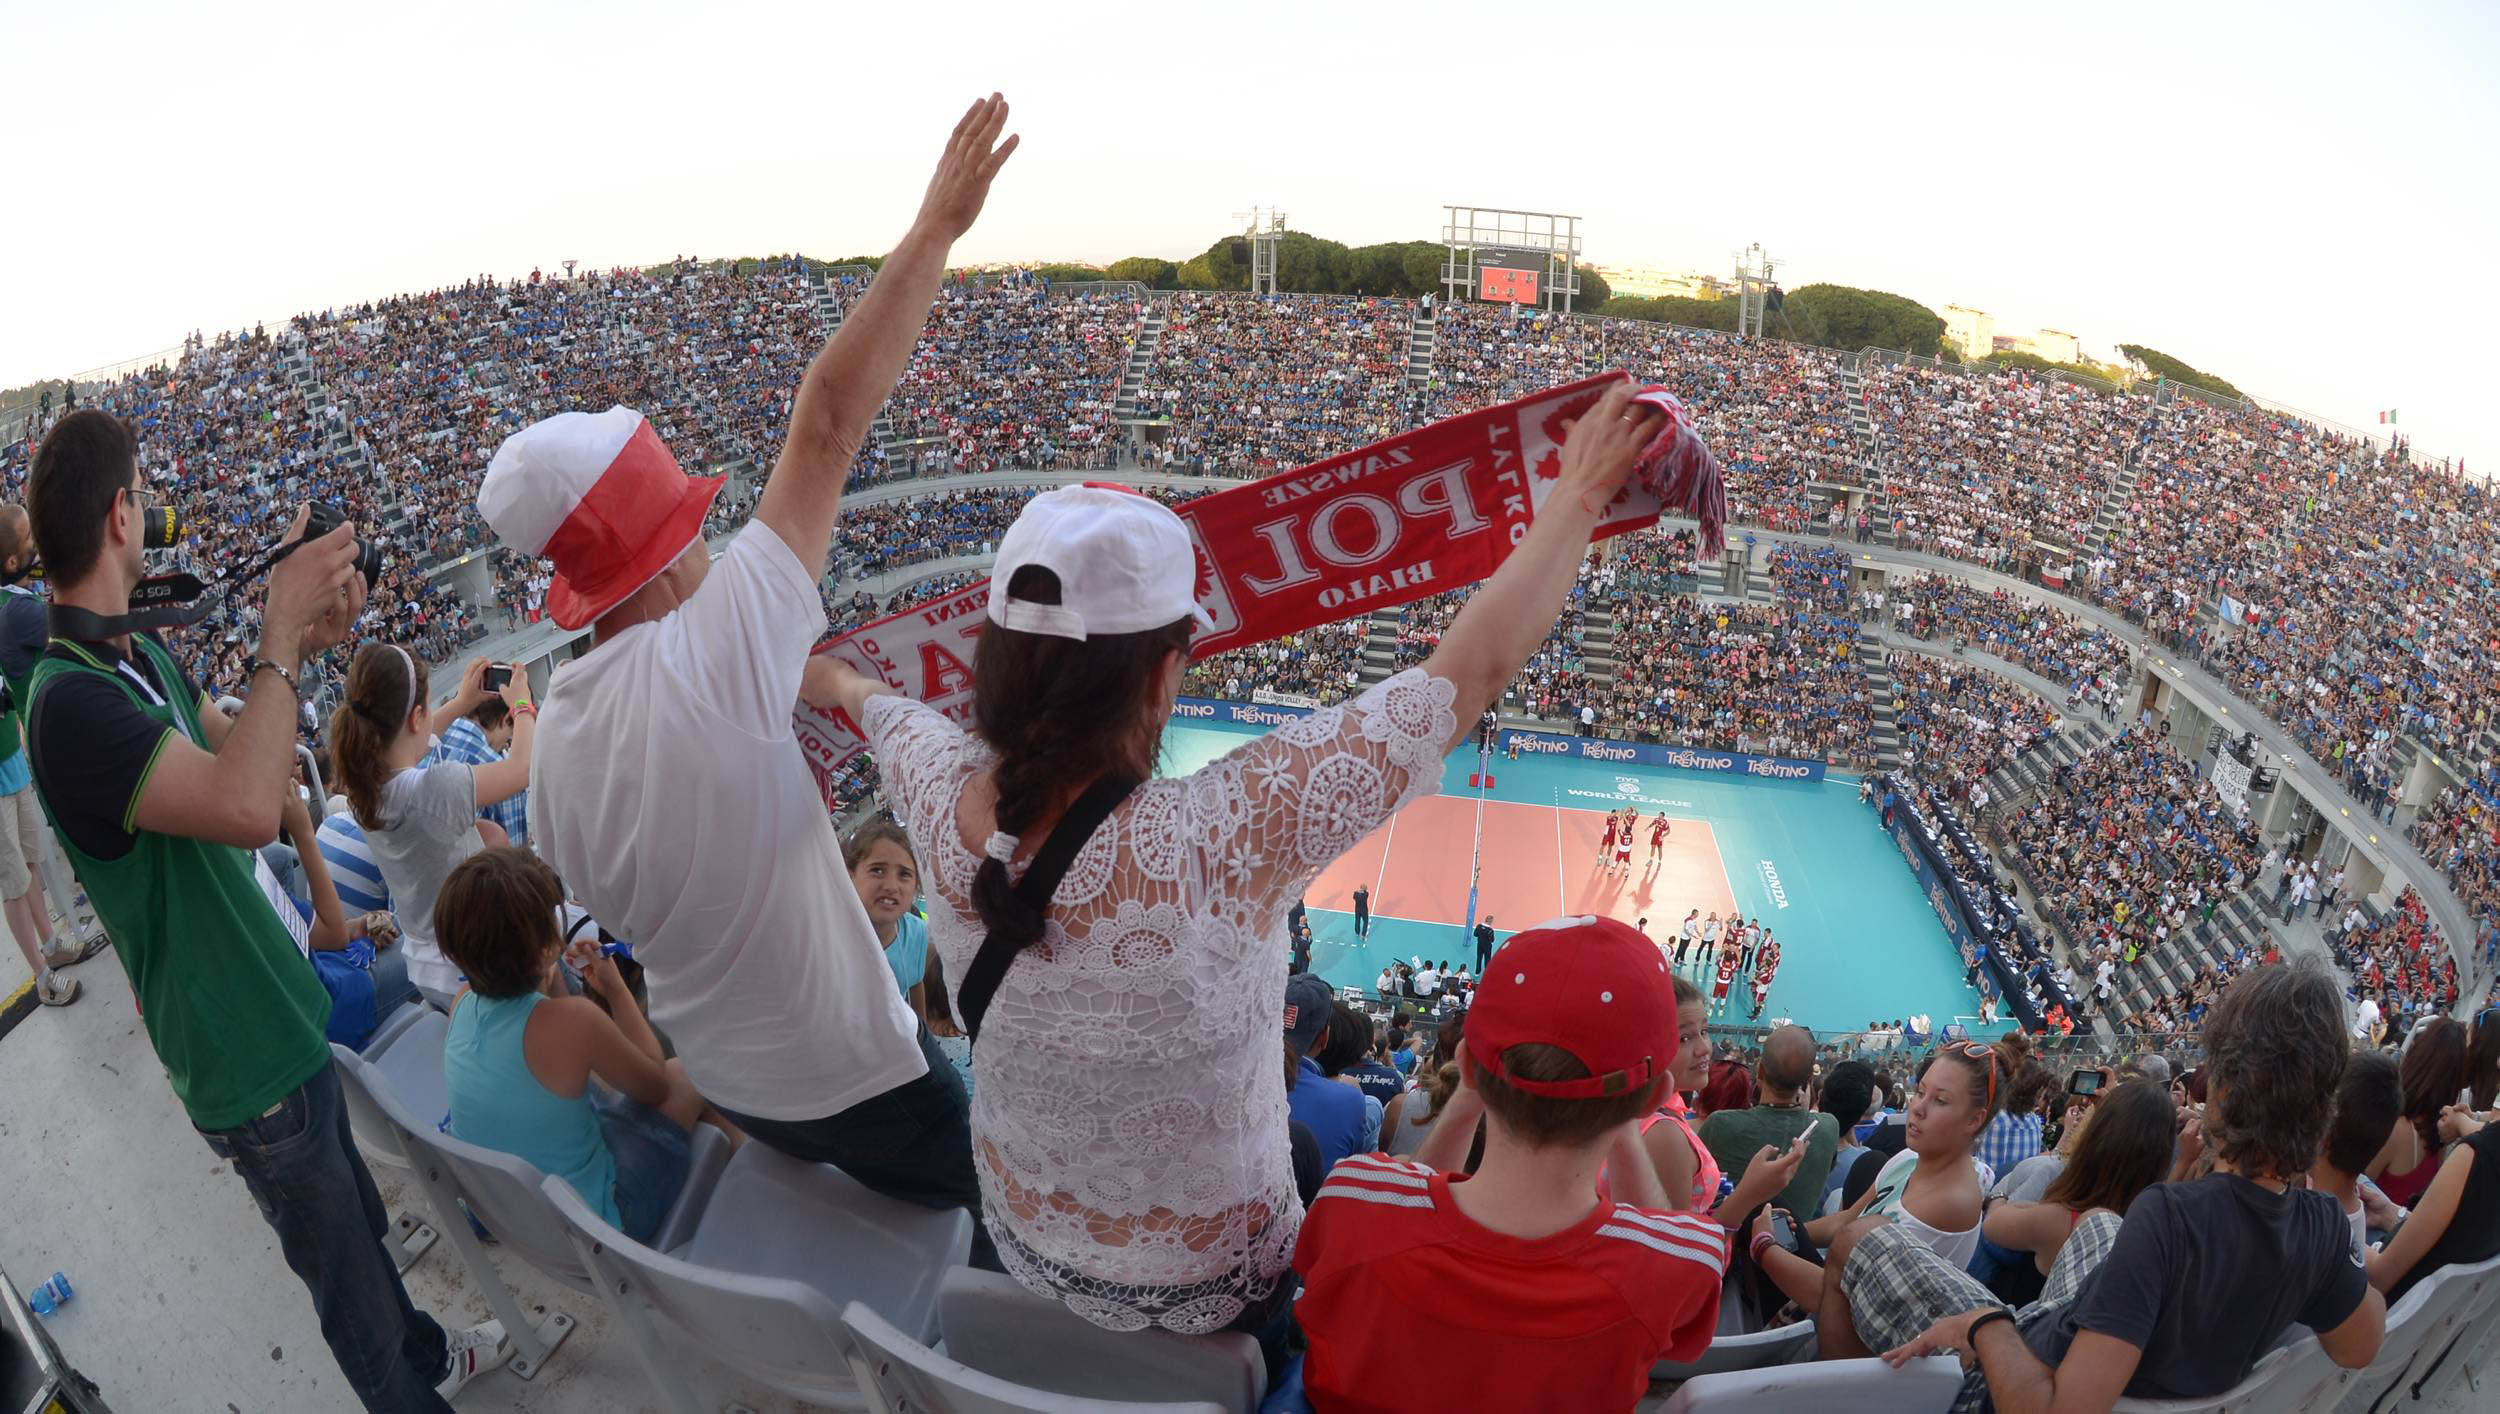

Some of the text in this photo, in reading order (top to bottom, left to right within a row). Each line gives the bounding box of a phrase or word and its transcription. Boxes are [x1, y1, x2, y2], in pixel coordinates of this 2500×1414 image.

[147, 585, 172, 598] EOS
[1172, 704, 1215, 717] NTINO
[1230, 706, 1298, 725] TRENTINO
[1518, 737, 1569, 753] RENTINO
[1581, 741, 1636, 760] TRENTINO
[1667, 750, 1732, 769] TRENTINO
[1747, 758, 1809, 778] TRENTINO
[1568, 789, 1626, 801] WORLD
[1629, 794, 1692, 808] LEAGUE
[1760, 859, 1789, 910] HONDA
